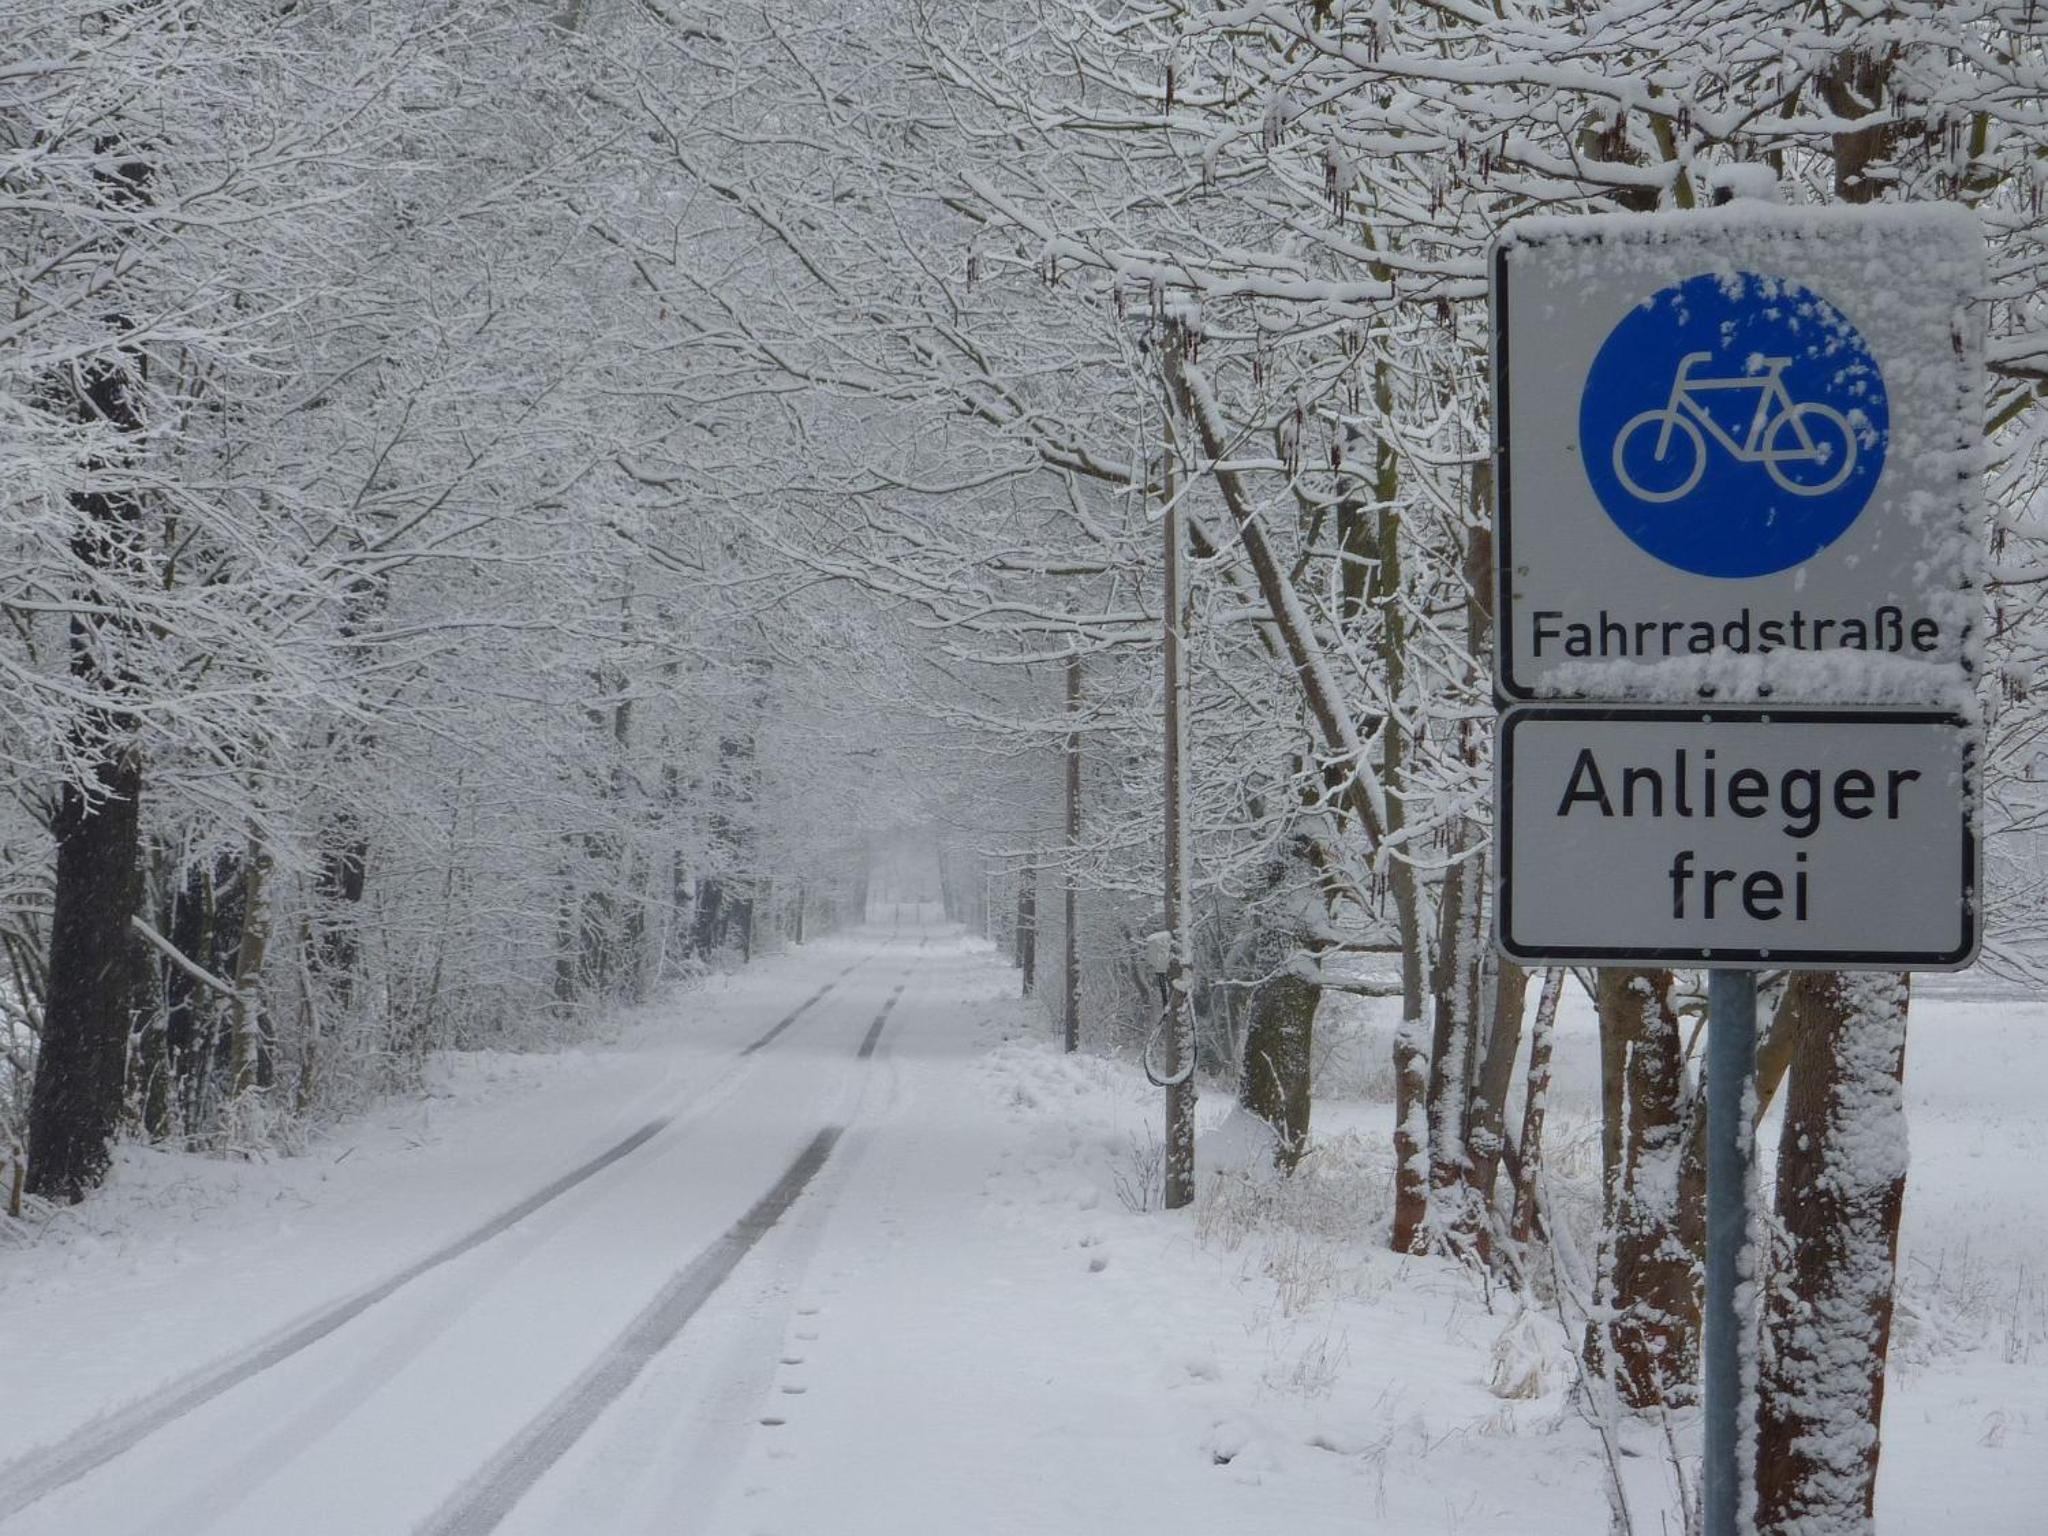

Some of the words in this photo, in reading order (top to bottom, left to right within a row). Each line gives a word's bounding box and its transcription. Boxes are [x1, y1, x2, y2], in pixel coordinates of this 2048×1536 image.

[1532, 605, 1940, 658] Fahrradstraße
[1556, 747, 1923, 840] Anlieger
[1668, 850, 1809, 923] frei
